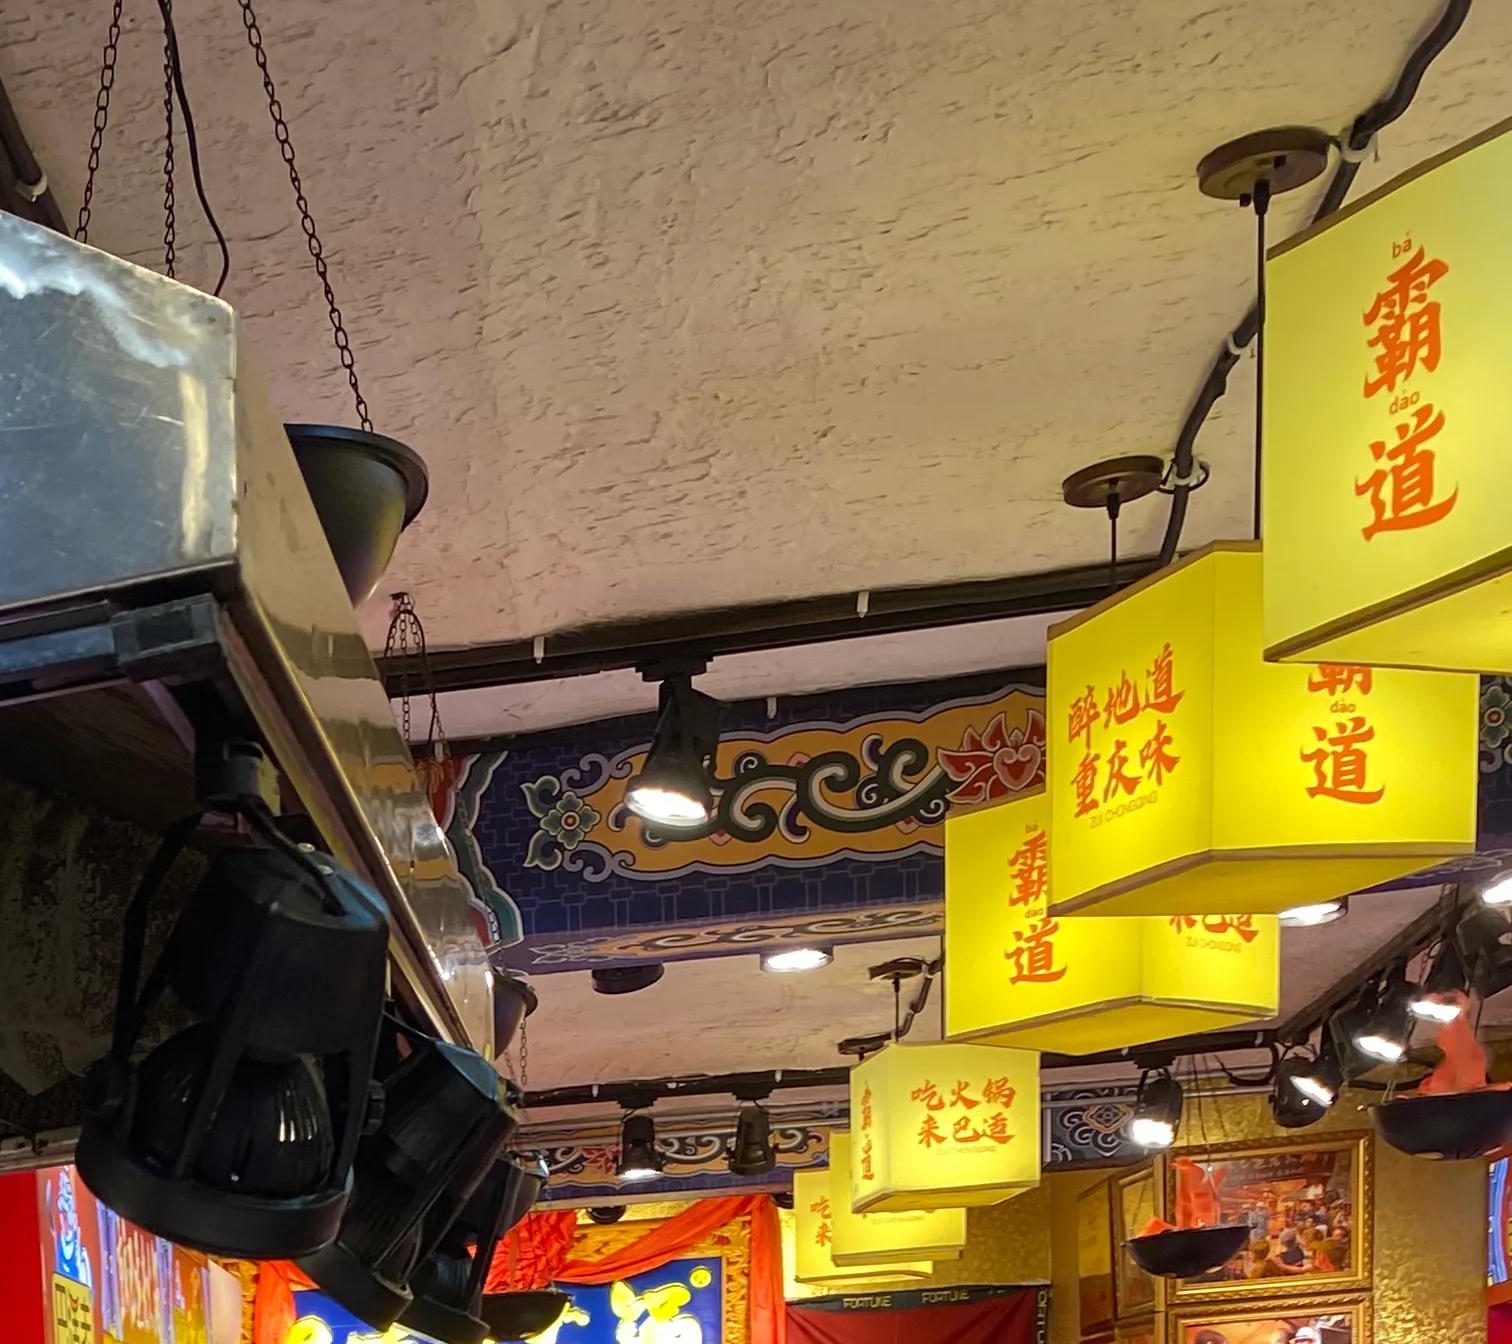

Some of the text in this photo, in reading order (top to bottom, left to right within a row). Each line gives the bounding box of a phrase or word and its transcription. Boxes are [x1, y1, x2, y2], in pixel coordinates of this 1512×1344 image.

[1070, 719, 1180, 819] 重庆味
[911, 1076, 1016, 1111] 吃火锅
[918, 1112, 1016, 1149] 来巴适
